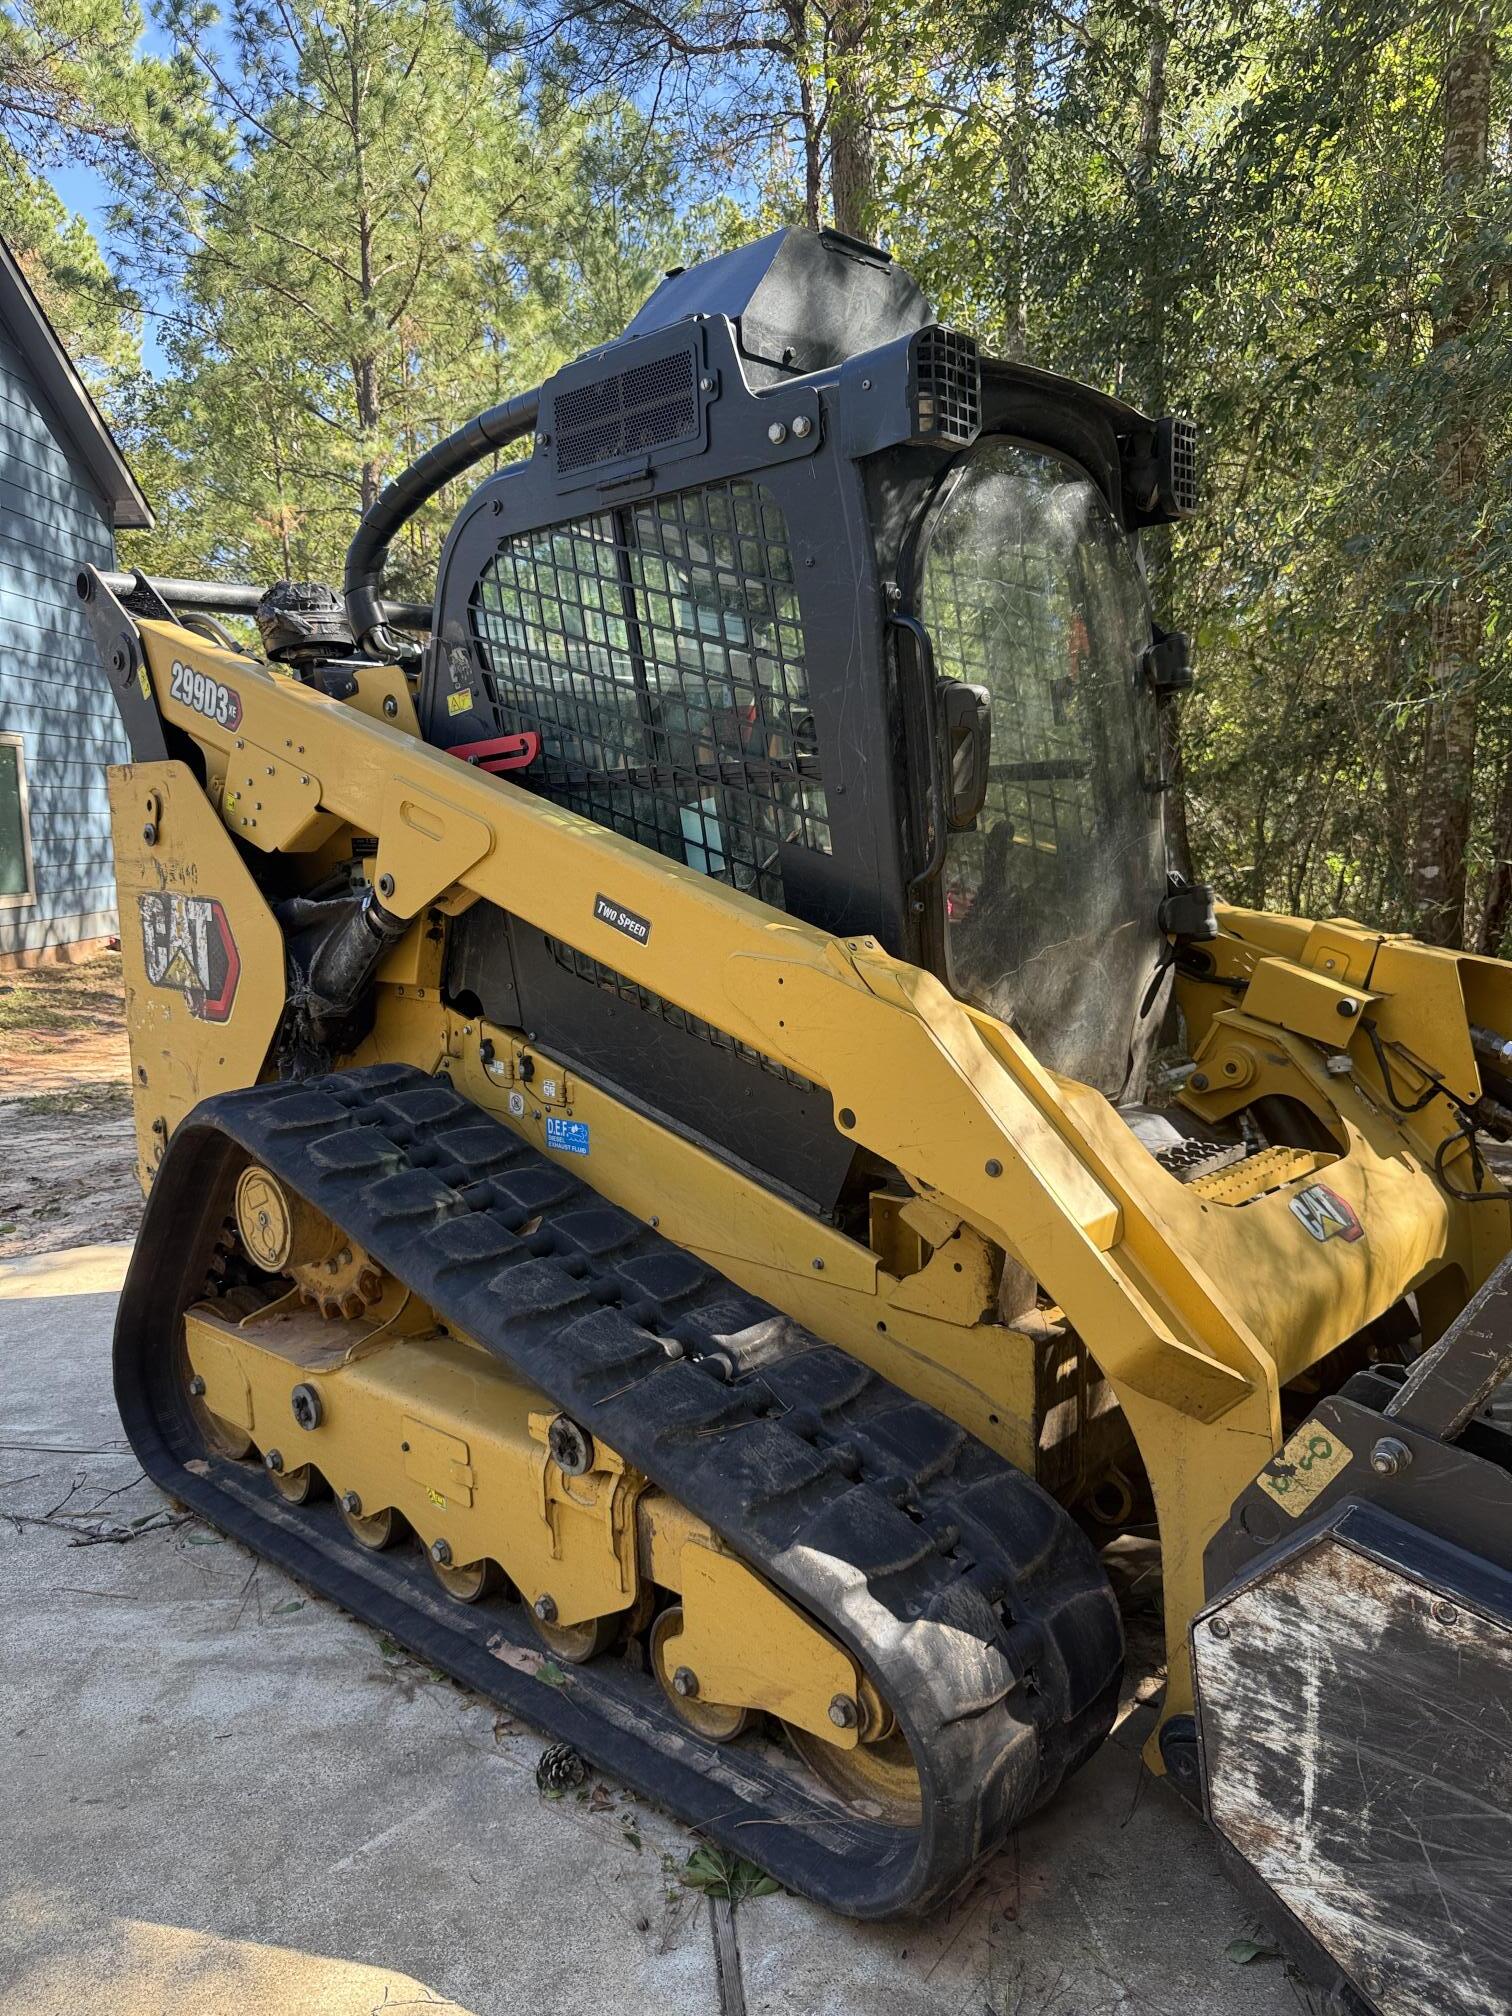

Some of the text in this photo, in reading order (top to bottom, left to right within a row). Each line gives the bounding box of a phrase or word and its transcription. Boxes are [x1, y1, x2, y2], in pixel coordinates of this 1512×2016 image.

[171, 662, 228, 724] 299D3
[140, 896, 213, 991] CAT
[597, 900, 647, 937] TWO SPEED
[571, 1146, 587, 1154] FLUID
[1288, 1186, 1348, 1240] CAT
